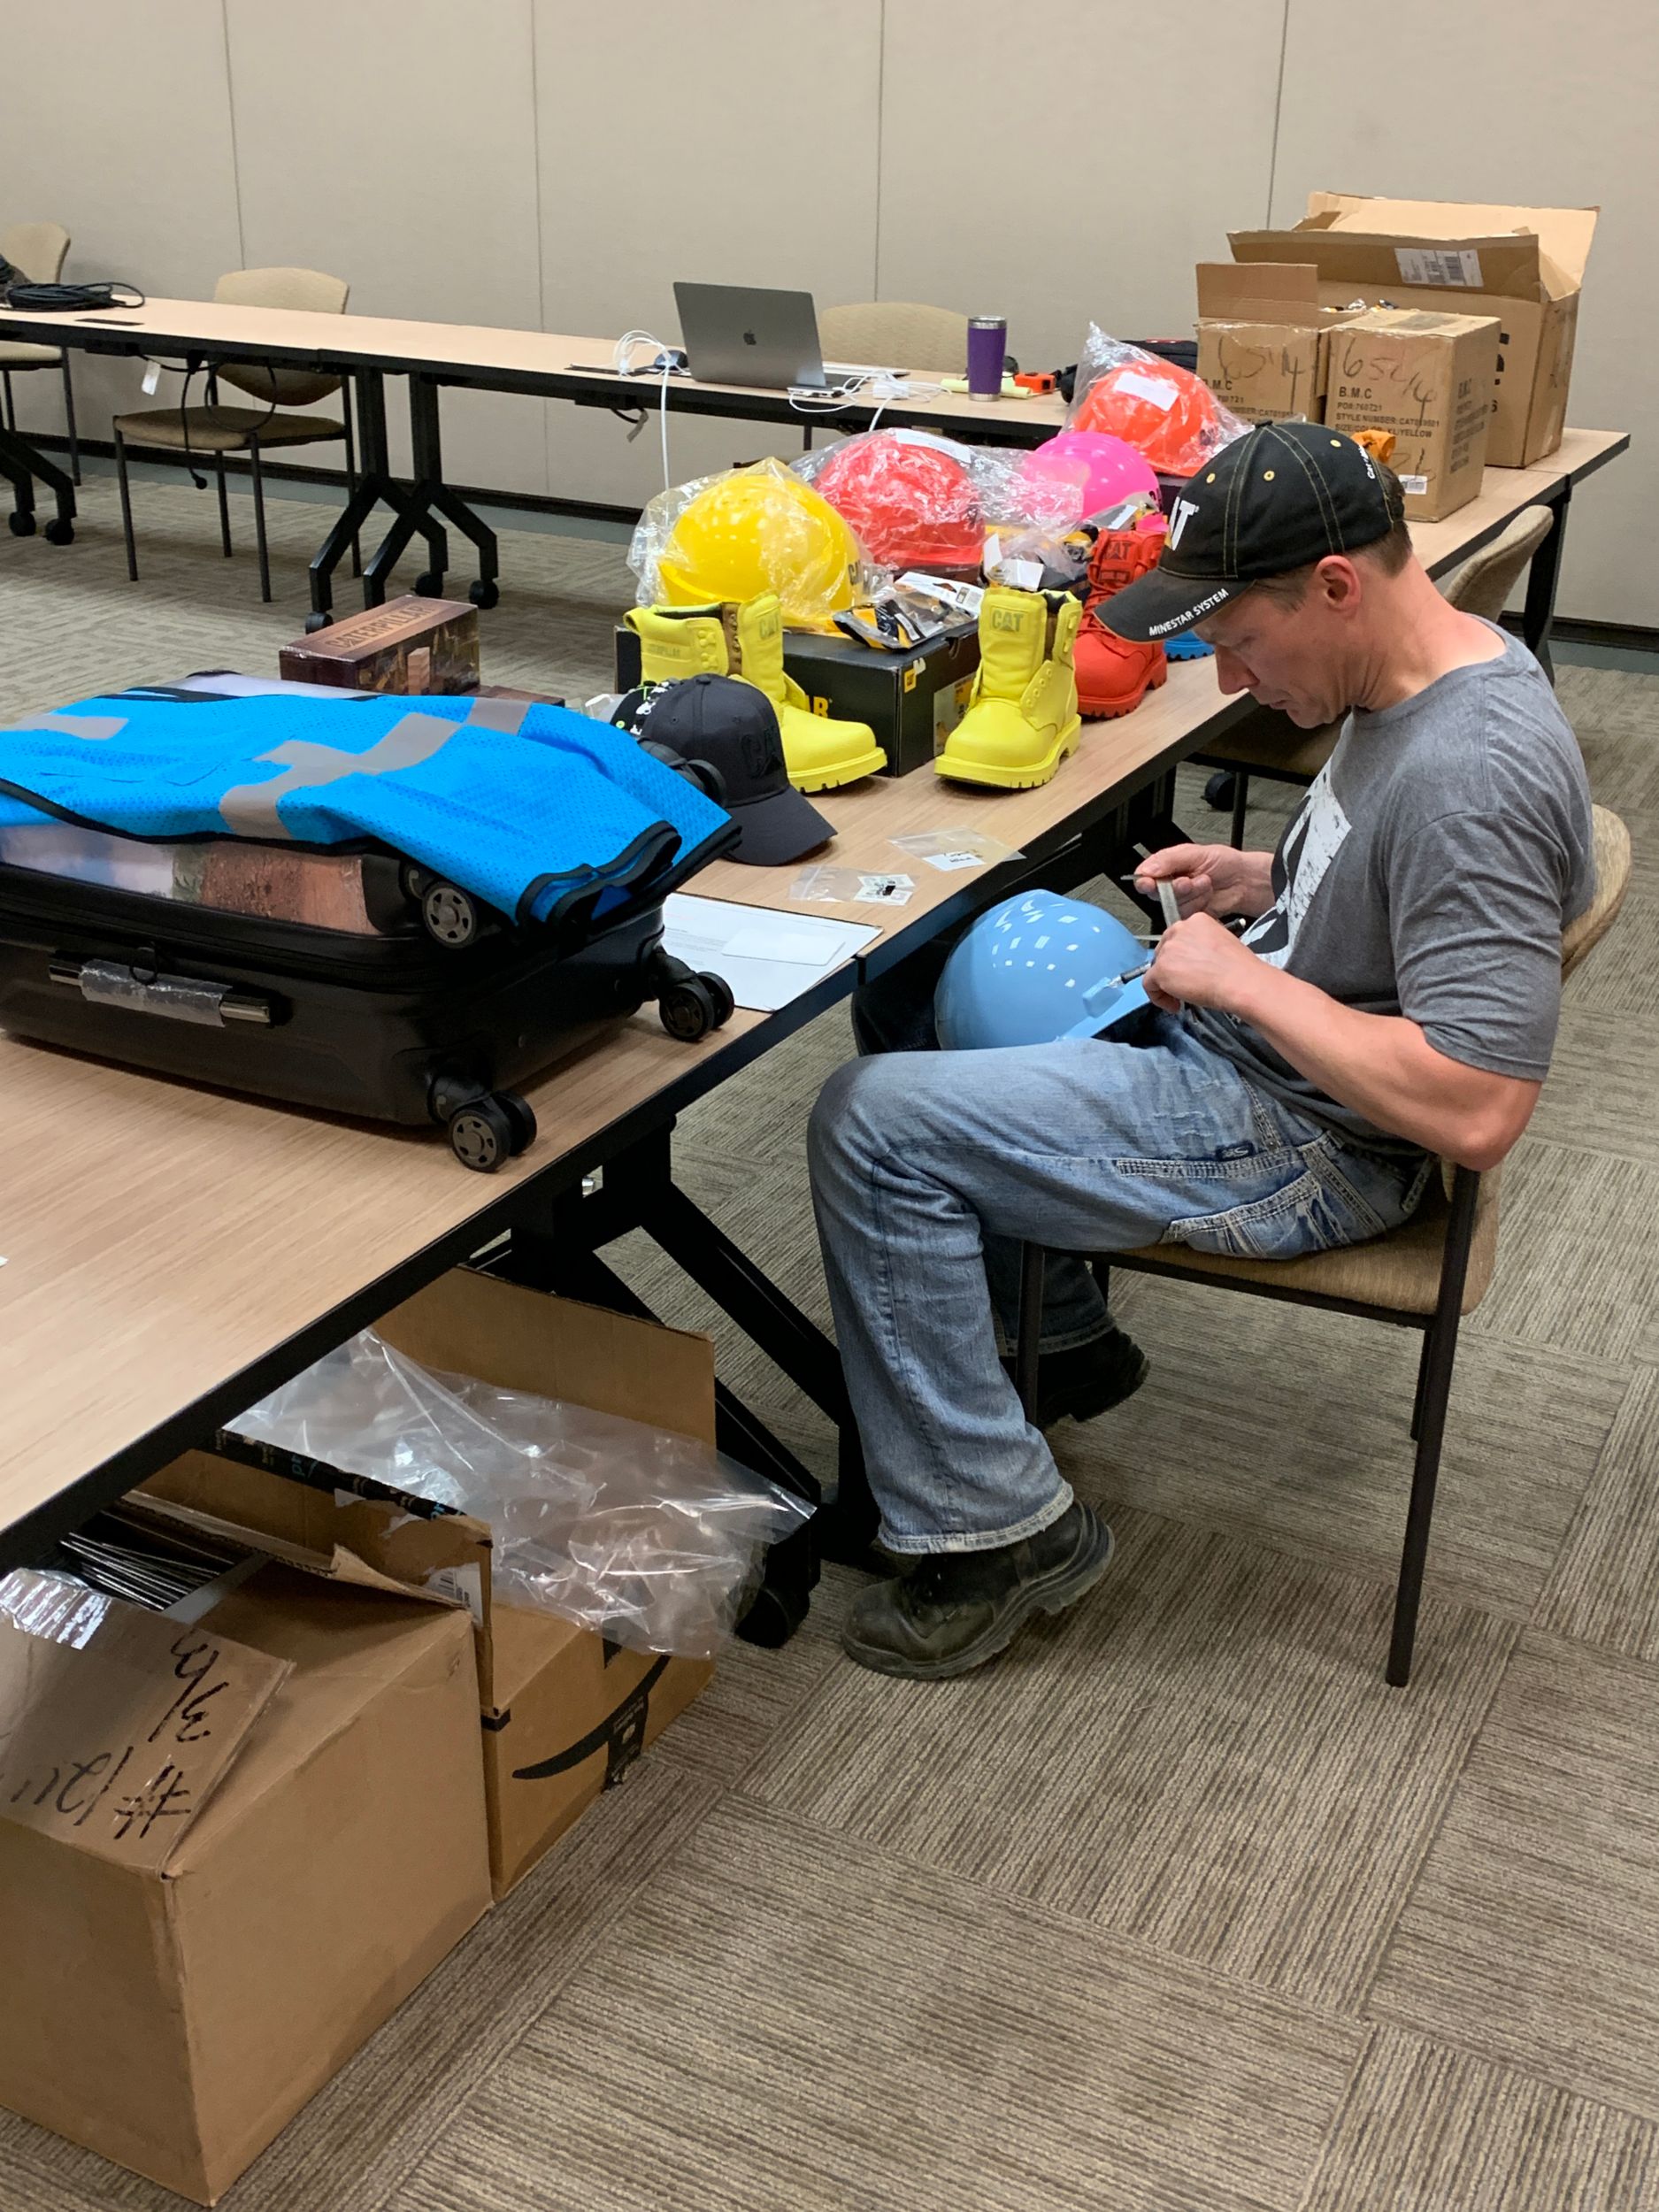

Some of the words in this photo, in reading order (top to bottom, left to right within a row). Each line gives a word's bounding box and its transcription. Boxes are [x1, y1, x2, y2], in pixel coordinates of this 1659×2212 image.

[1339, 386, 1372, 399] B.M.C
[991, 611, 1025, 633] CAT
[1148, 611, 1194, 636] MINESTAR
[1193, 588, 1229, 616] SYSTEM
